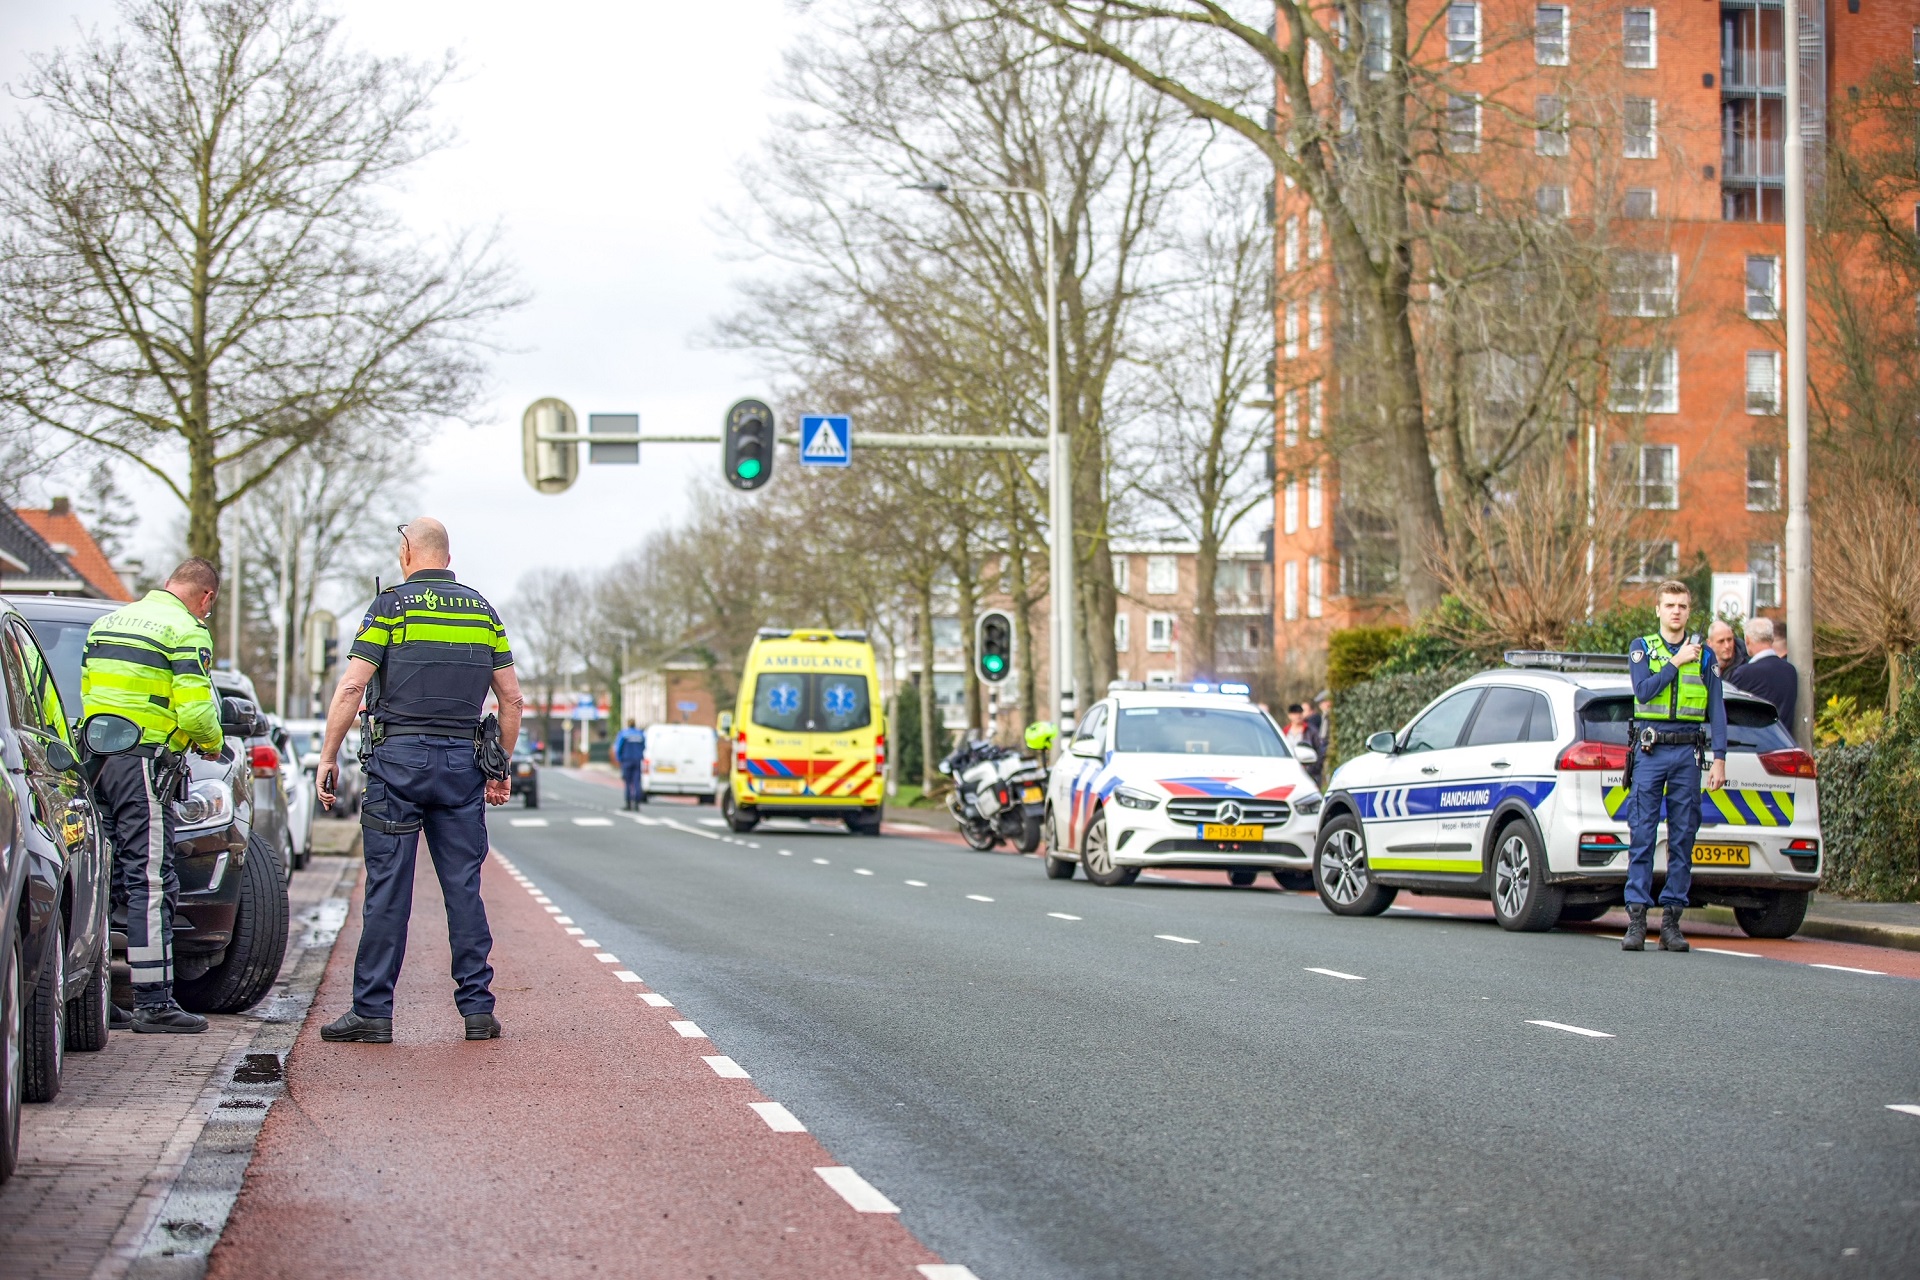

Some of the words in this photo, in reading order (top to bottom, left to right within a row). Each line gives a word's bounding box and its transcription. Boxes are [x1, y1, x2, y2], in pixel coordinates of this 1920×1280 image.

[414, 588, 480, 611] POLITIE
[1722, 600, 1739, 616] 30
[764, 655, 862, 669] AMBULANCE
[1740, 781, 1792, 789] handhavingmeppel
[1440, 789, 1490, 807] HANDHAVING
[1207, 827, 1254, 838] P-138-JX
[1441, 822, 1457, 832] Meppel
